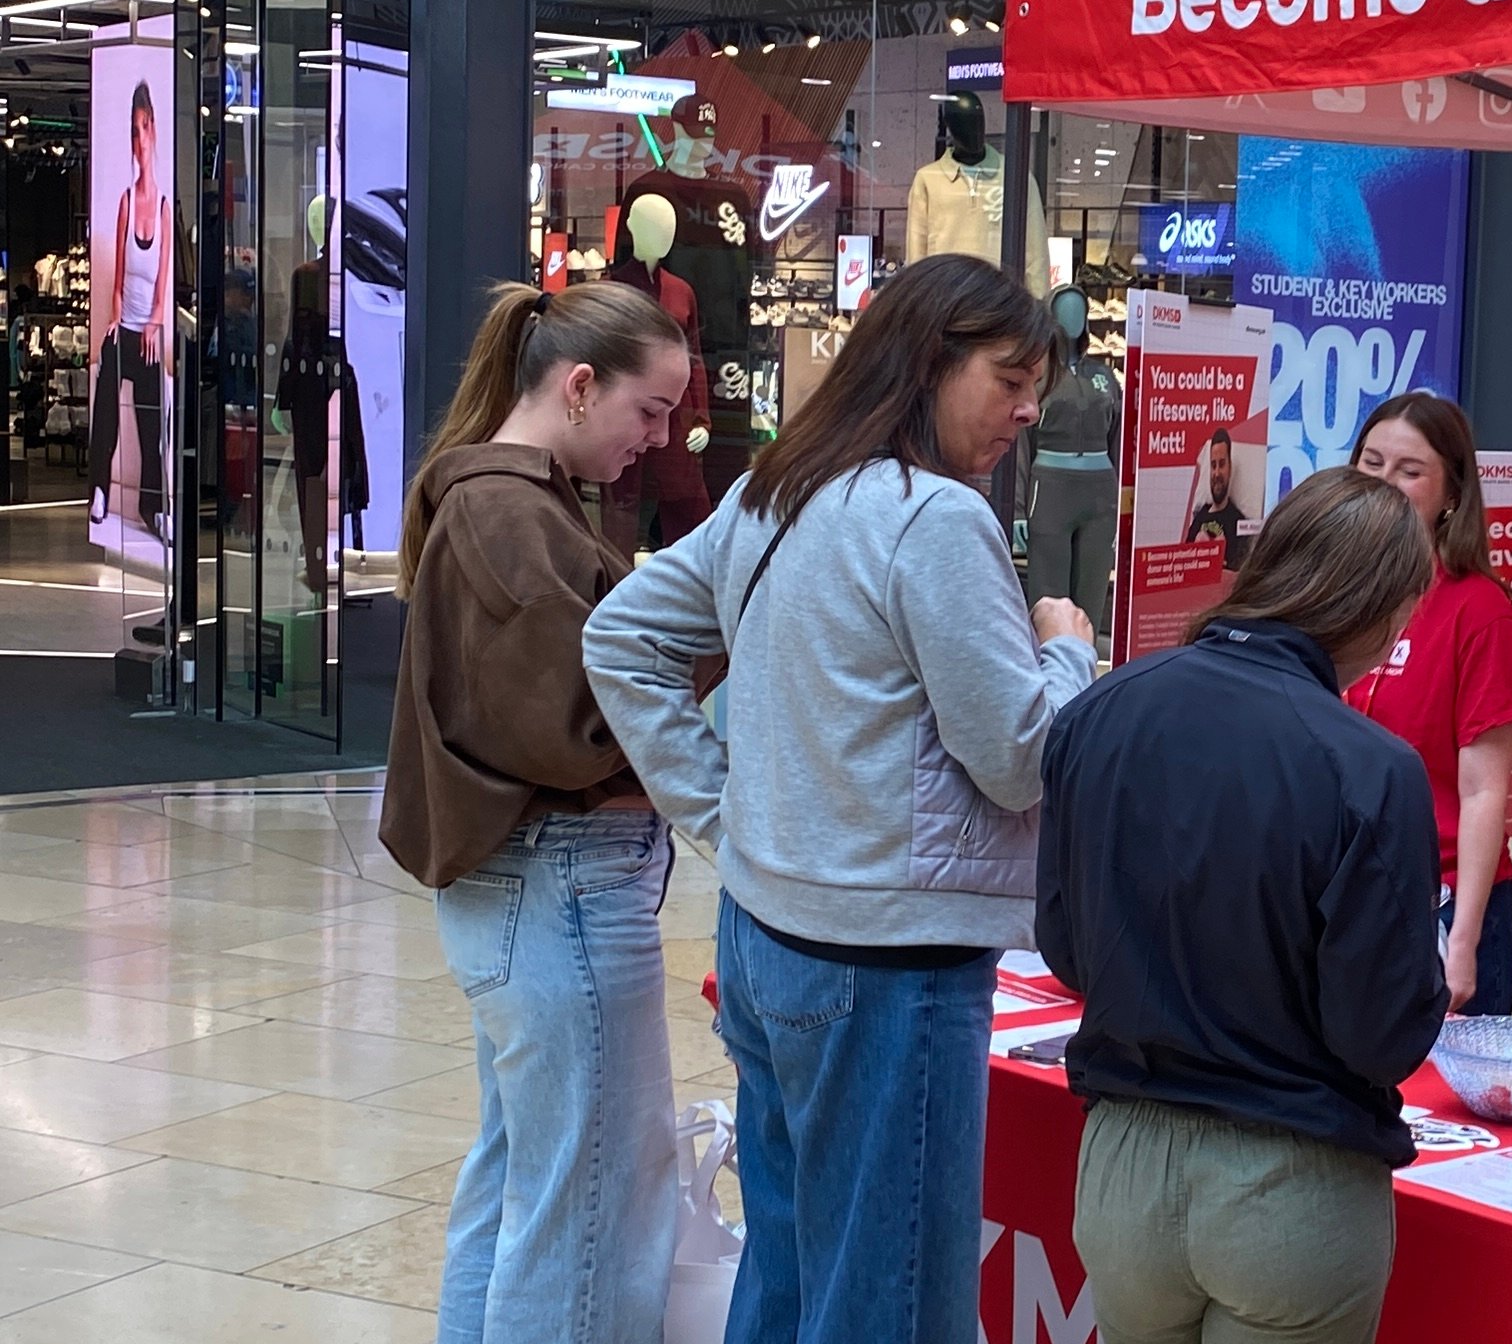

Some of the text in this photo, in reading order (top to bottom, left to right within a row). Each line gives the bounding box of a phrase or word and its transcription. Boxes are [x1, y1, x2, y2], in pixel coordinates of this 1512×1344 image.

[970, 62, 1004, 78] FOOTWEA
[610, 88, 674, 102] FOOTWEAR
[773, 166, 813, 201] NIKE
[1251, 273, 1447, 305] STUDENT & KEY WORKERS
[1312, 297, 1393, 320] EXCLUSIVE
[1151, 366, 1244, 391] You could be a
[1149, 397, 1235, 424] lifesaver, like
[1148, 431, 1185, 455] Matt!
